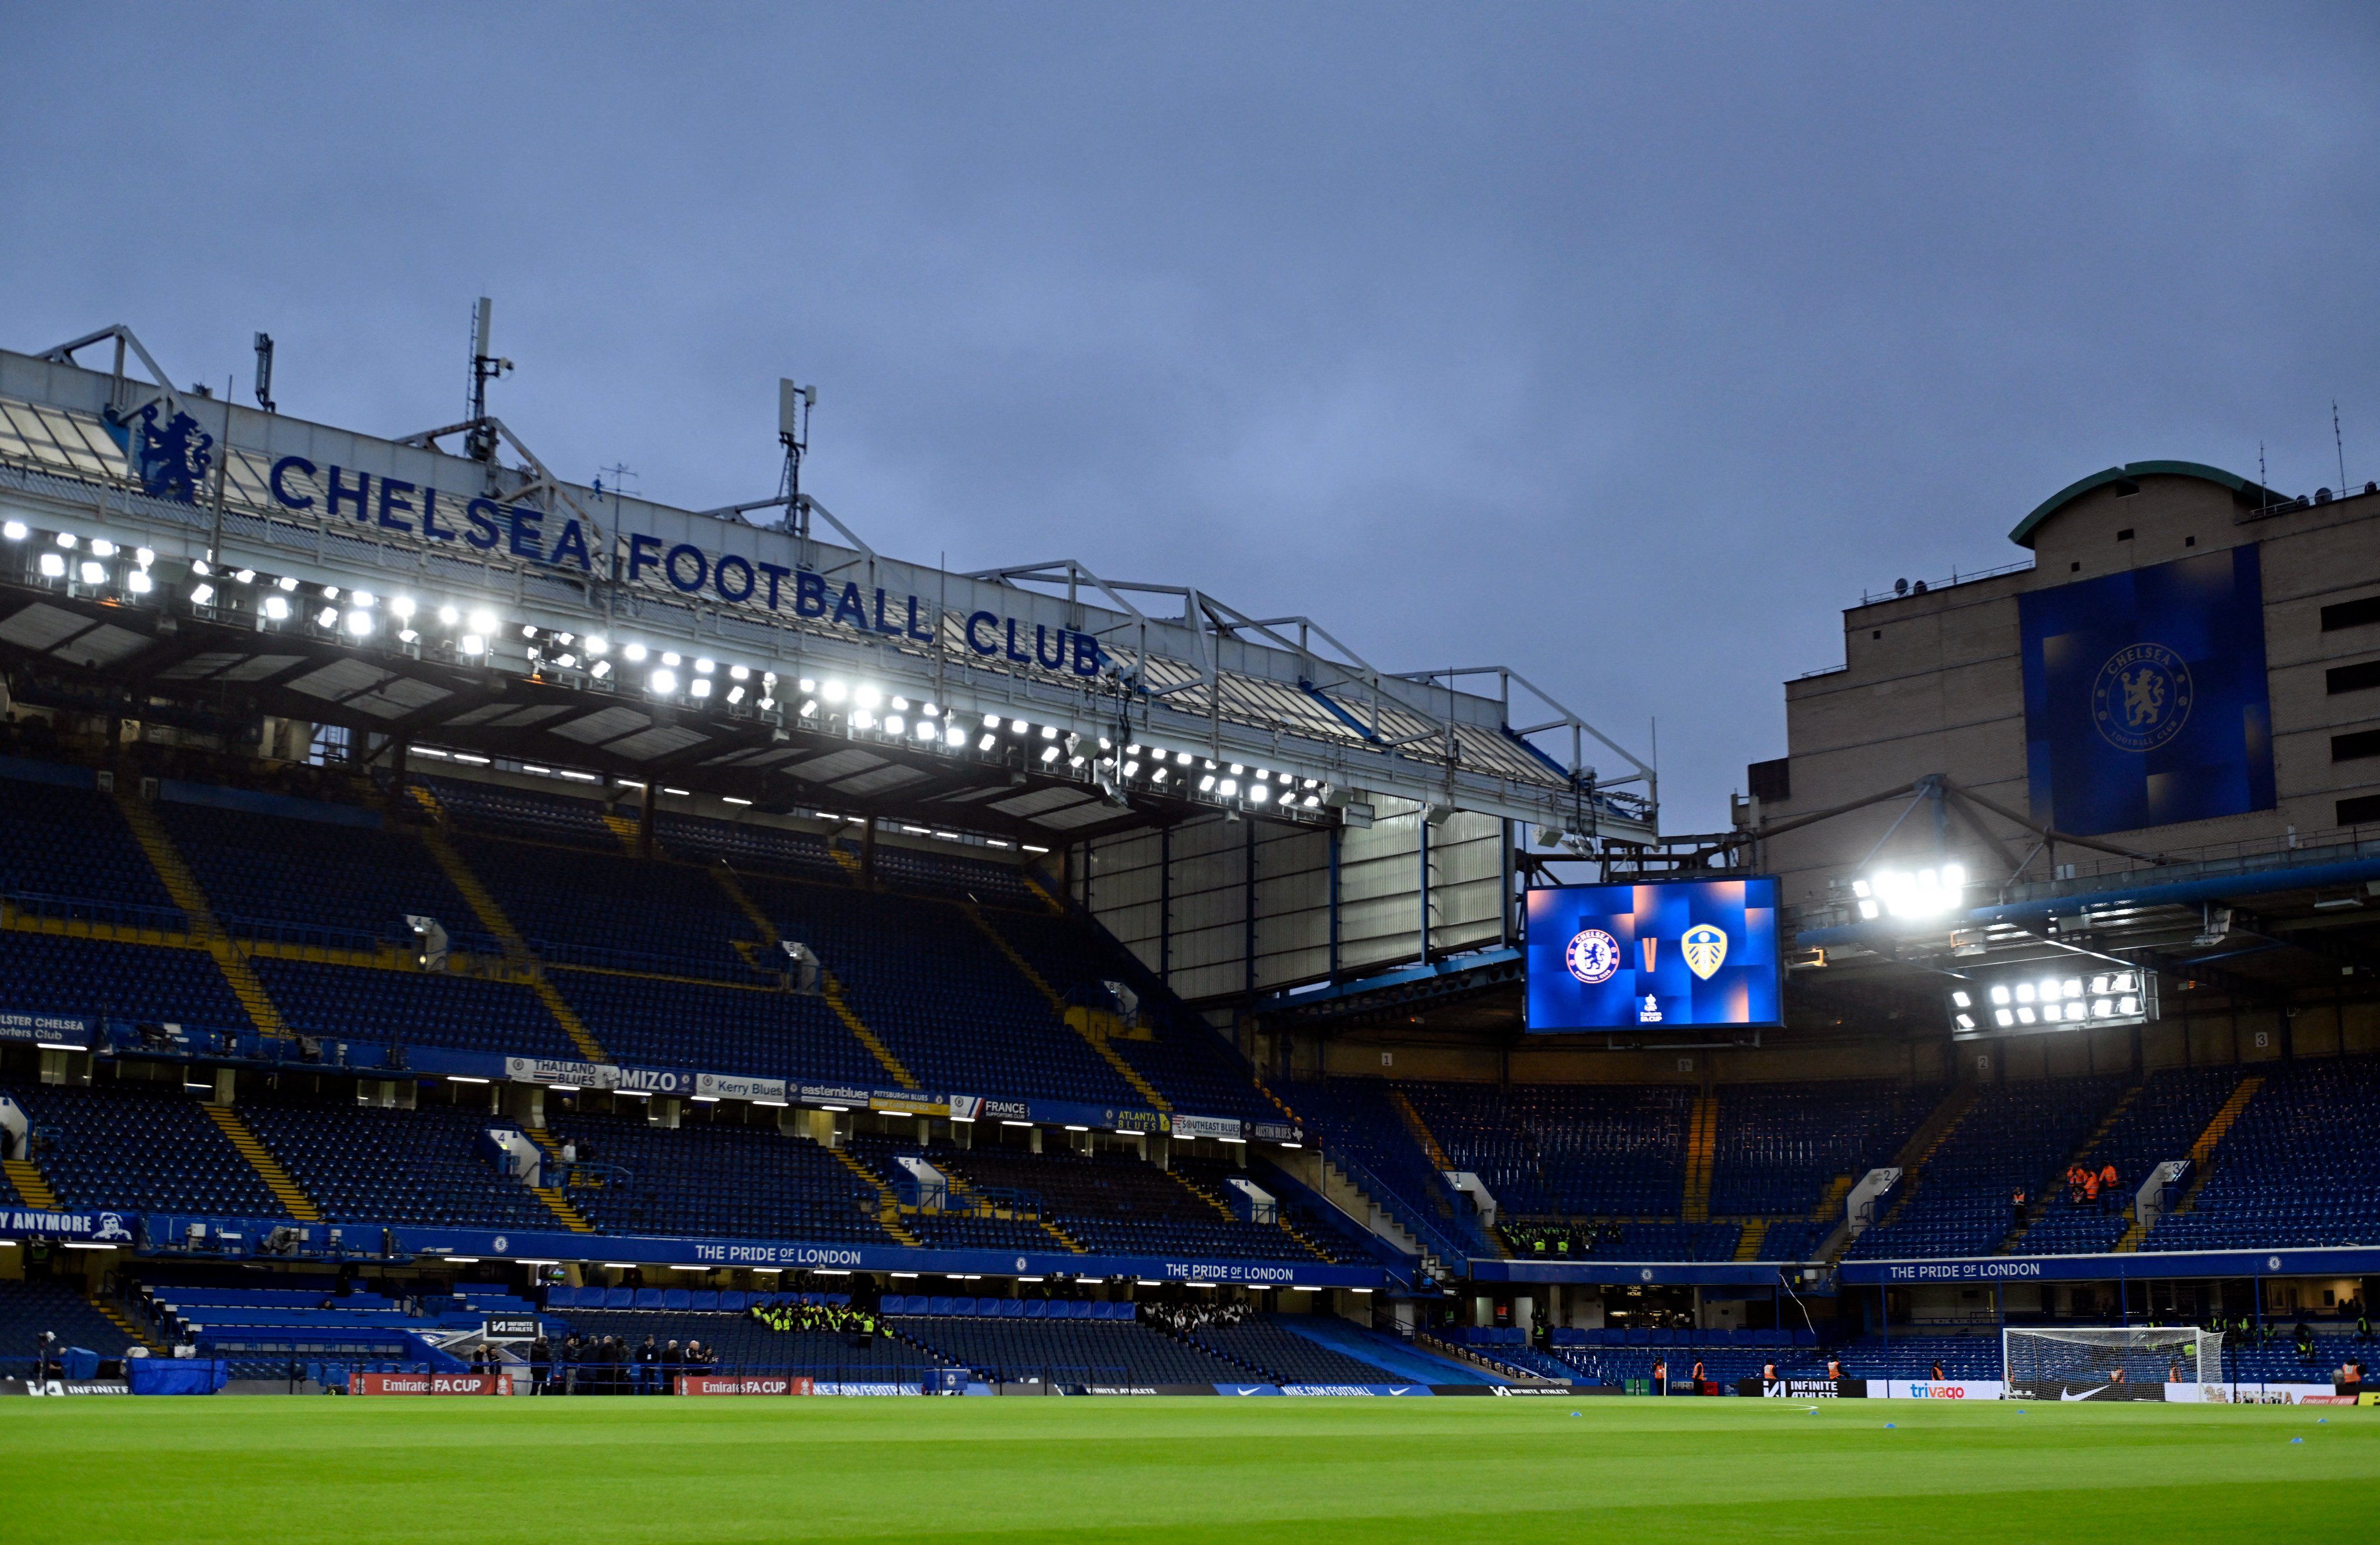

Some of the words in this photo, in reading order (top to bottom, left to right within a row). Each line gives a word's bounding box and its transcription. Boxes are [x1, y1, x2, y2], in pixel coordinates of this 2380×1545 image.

[270, 456, 592, 571] CHELSEA
[630, 533, 933, 642] FOOTBALL
[966, 610, 1100, 676] CLUB
[2107, 647, 2170, 675] CHELSEA
[2110, 731, 2153, 746] FOOTBALL
[2157, 720, 2177, 739] CLUB
[1575, 931, 1610, 944] CHELSEA
[1642, 937, 1657, 973] V
[0, 1015, 32, 1026] LSTER
[35, 1017, 84, 1031] CHELSEA
[35, 1029, 62, 1040] Club
[2258, 1034, 2265, 1046] 3
[1384, 1056, 1389, 1064] 1
[1981, 1058, 1986, 1068] 2
[534, 1060, 596, 1074] THAILAND
[557, 1073, 596, 1087] BLUES
[621, 1069, 677, 1091] MIZO
[718, 1081, 749, 1095] Kerry
[752, 1083, 783, 1096] Blues
[801, 1085, 869, 1099] easternblues
[873, 1090, 909, 1100] PITTSBURGH
[911, 1093, 929, 1101] BLUES
[985, 1101, 1025, 1114] FRANCE
[1119, 1110, 1156, 1122] ATLANTA
[1118, 1121, 1156, 1131] BLUES
[1221, 1123, 1239, 1133] BLUES
[1255, 1124, 1274, 1138] AUSTIN
[1275, 1126, 1291, 1139] BLUES
[498, 1132, 505, 1142] 4
[905, 1160, 910, 1170] 5
[2173, 1163, 2179, 1174] 3
[1456, 1173, 1461, 1183] 1
[1884, 1170, 1890, 1181] 2
[12, 1213, 92, 1232] ANYMORE
[696, 1245, 725, 1260] THE
[730, 1246, 776, 1261] PRIDE
[779, 1248, 795, 1262] OF
[798, 1249, 861, 1265] LONDON
[1166, 1263, 1189, 1277] THE
[1192, 1264, 1228, 1278] PRIDE
[1231, 1266, 1242, 1278] OF
[1245, 1267, 1293, 1281] LONDON
[1890, 1267, 1915, 1278] THE
[1919, 1266, 1960, 1278] PRIDE
[1963, 1265, 1977, 1277] OF
[1980, 1263, 2040, 1276] LONDON
[67, 1385, 129, 1394] INFINITE
[382, 1379, 433, 1392] Emirates
[435, 1379, 451, 1392] FA
[453, 1379, 481, 1392] CUP
[702, 1381, 745, 1393] Emirates
[746, 1381, 760, 1393] FA
[762, 1381, 787, 1393] CUP
[1280, 1386, 1375, 1396] NIKE.COM/FOOTBALL
[1790, 1381, 1838, 1391] INFINITE
[1910, 1383, 1965, 1399] trivago
